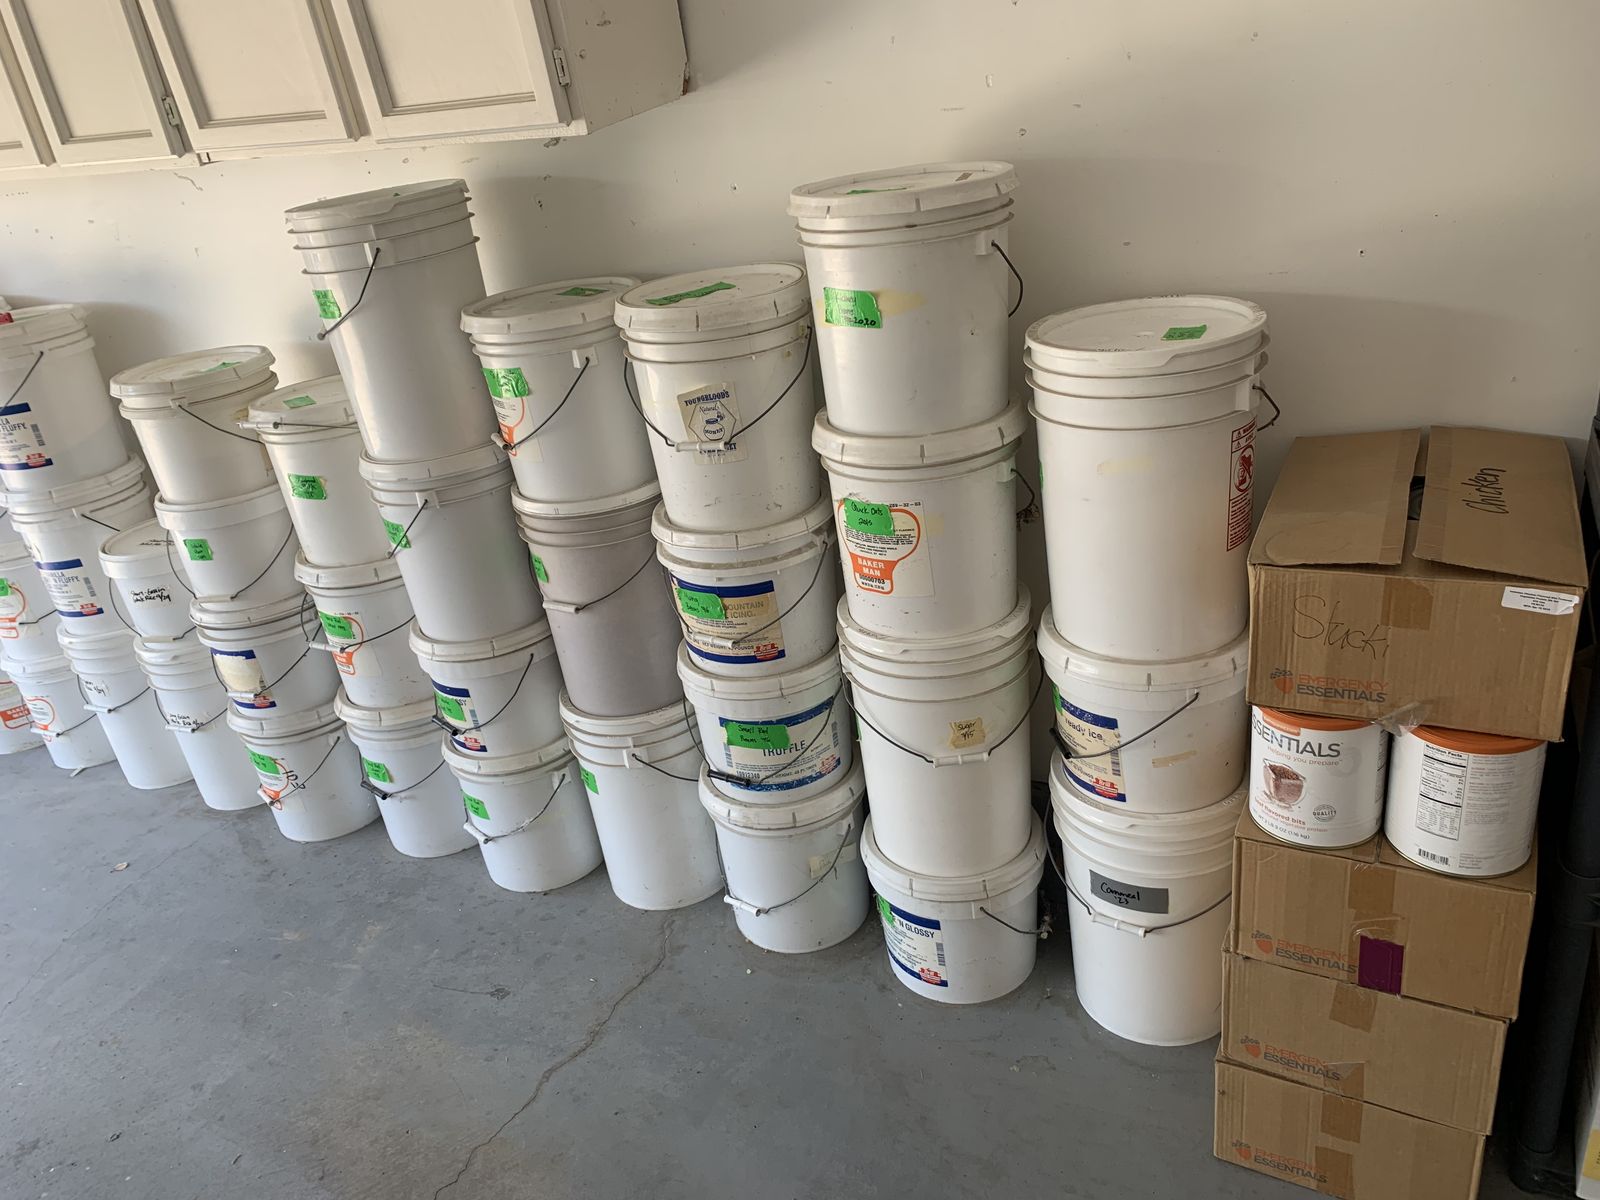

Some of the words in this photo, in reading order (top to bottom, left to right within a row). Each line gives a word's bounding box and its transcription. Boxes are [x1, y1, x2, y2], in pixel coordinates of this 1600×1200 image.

[1461, 468, 1509, 514] Chicken
[857, 557, 885, 569] BAKER
[862, 566, 881, 577] MAN
[725, 600, 764, 611] OUNTAIN
[1298, 673, 1389, 692] EMERGENCY
[1296, 684, 1388, 703] ESSENTIALS
[1065, 718, 1086, 736] ready
[1088, 728, 1103, 741] ice
[762, 740, 806, 757] TRUFFLE
[1425, 744, 1447, 754] Nutrition
[1293, 756, 1307, 764] you
[1308, 759, 1340, 767] prepare
[1291, 817, 1306, 826] bits
[905, 923, 935, 939] GLOSSY
[1275, 947, 1358, 974] ESSENTIALS
[1263, 1051, 1341, 1081] ESSENTIALS
[1254, 1155, 1329, 1184] ESSENTIALS
